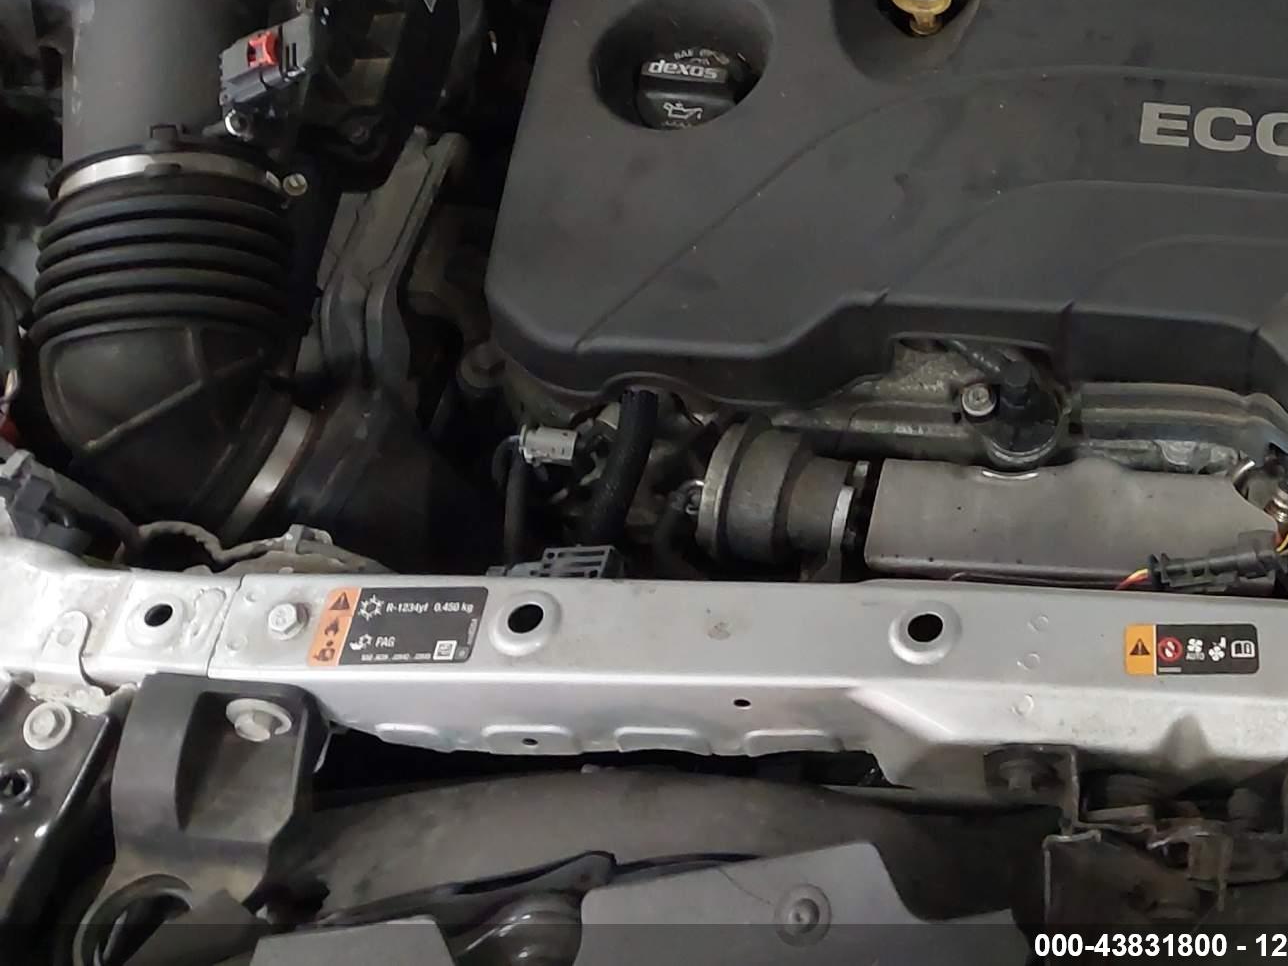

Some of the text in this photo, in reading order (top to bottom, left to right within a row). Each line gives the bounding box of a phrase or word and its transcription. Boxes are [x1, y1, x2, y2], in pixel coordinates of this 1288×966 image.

[648, 59, 718, 79] dexos
[461, 601, 474, 614] kg
[375, 636, 396, 648] PAG
[1186, 652, 1205, 661] AUTO
